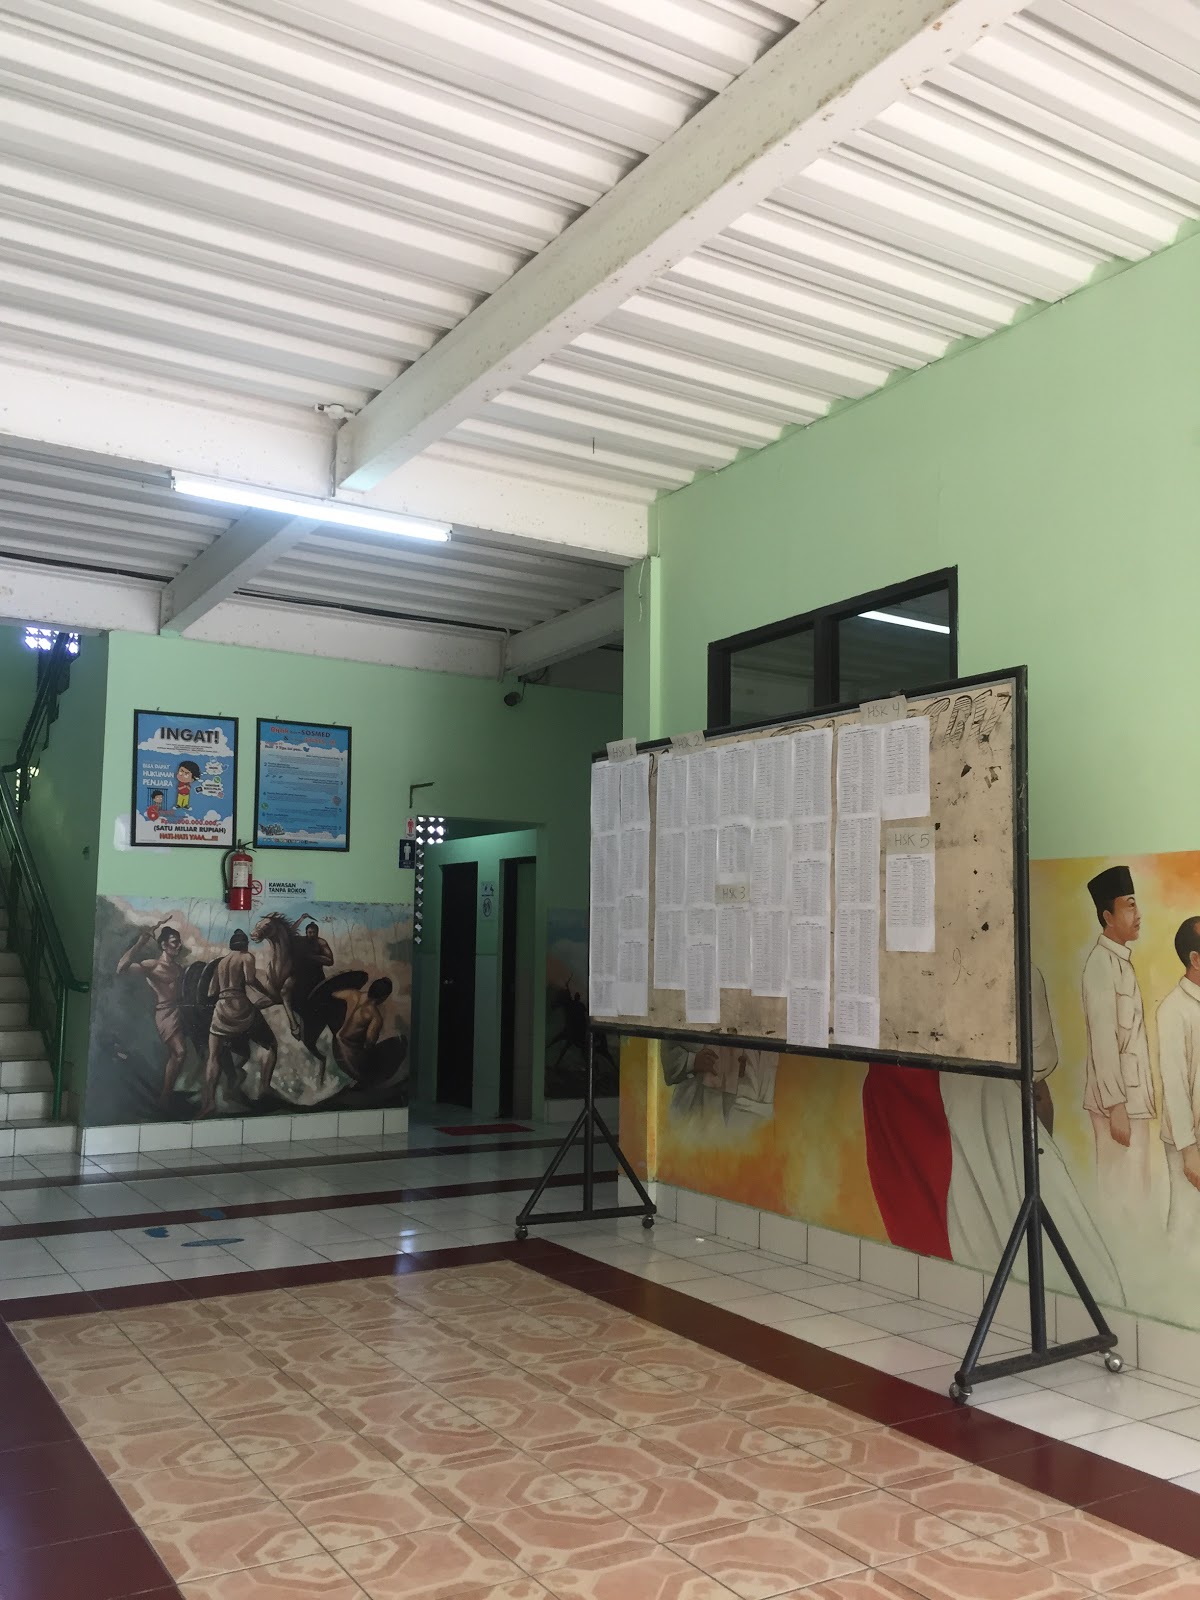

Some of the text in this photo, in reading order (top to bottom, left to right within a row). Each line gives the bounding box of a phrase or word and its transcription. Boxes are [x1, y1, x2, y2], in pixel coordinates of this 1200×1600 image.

[867, 702, 900, 719] HSK 4
[160, 726, 220, 744] INGAT!
[676, 734, 703, 749] HSK 2
[612, 744, 626, 759] HSK
[142, 770, 175, 778] HUKUMAN
[142, 778, 174, 788] PENJARA
[153, 824, 227, 834] (SATU MILIAR RUPIAH)
[894, 832, 930, 849] HSK 5
[722, 886, 746, 900] HSK 3
